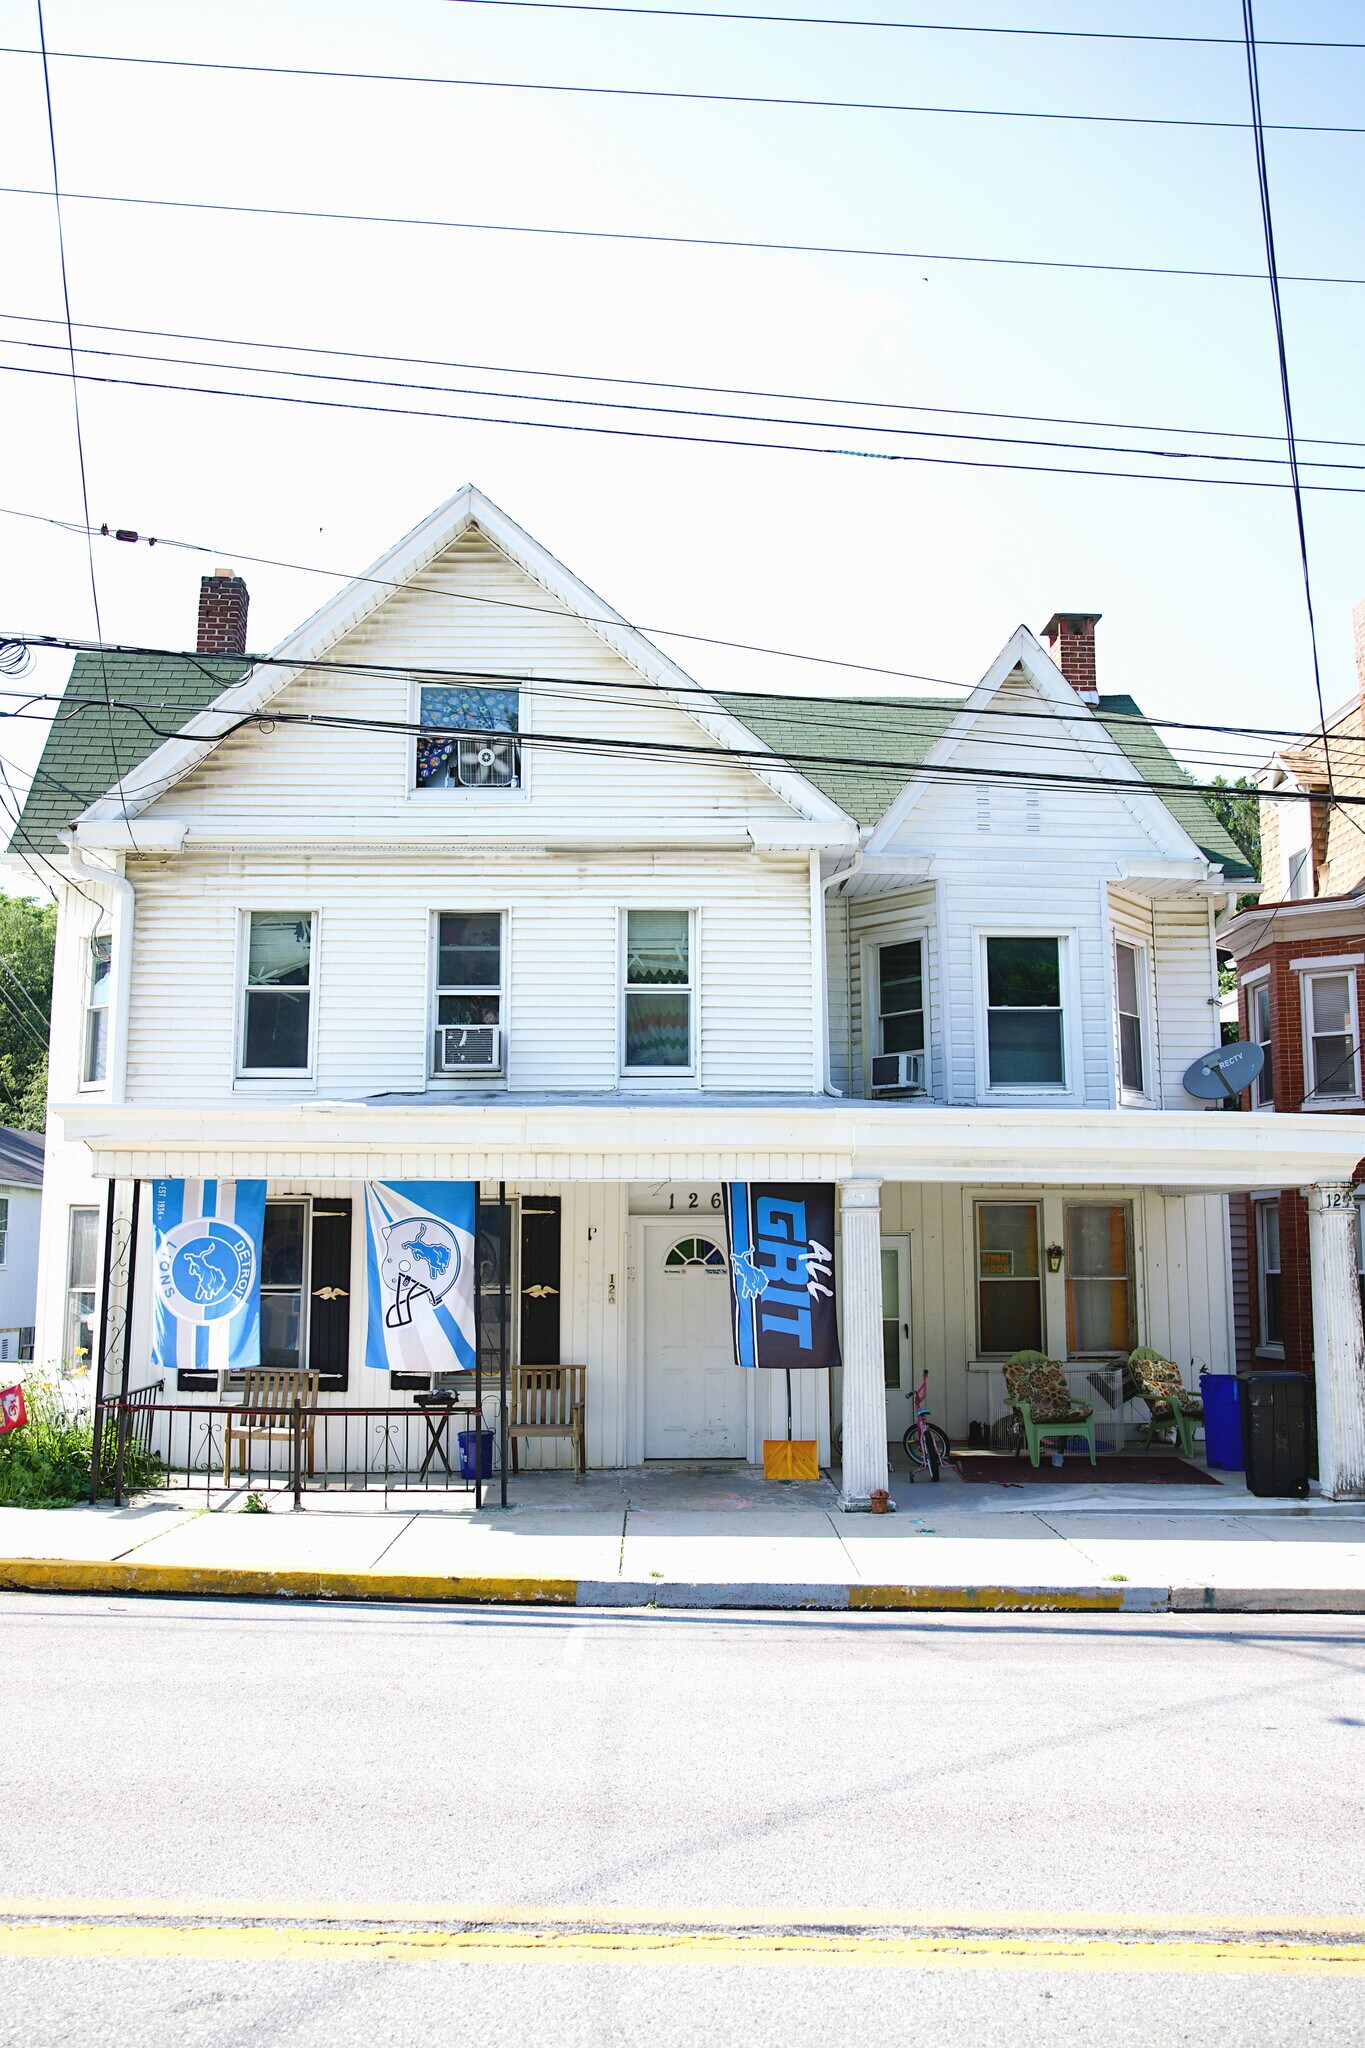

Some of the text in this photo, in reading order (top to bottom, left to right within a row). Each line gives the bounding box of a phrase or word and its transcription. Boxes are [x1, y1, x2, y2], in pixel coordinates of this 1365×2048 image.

[1219, 1052, 1243, 1069] RECTV
[157, 1201, 165, 1215] 1934
[669, 1192, 722, 1210] 126
[160, 1241, 178, 1298] LIONS
[231, 1240, 252, 1304] DETROIT
[608, 1273, 616, 1304] 126
[756, 1196, 813, 1350] GRIT
[798, 1239, 834, 1302] ALL
